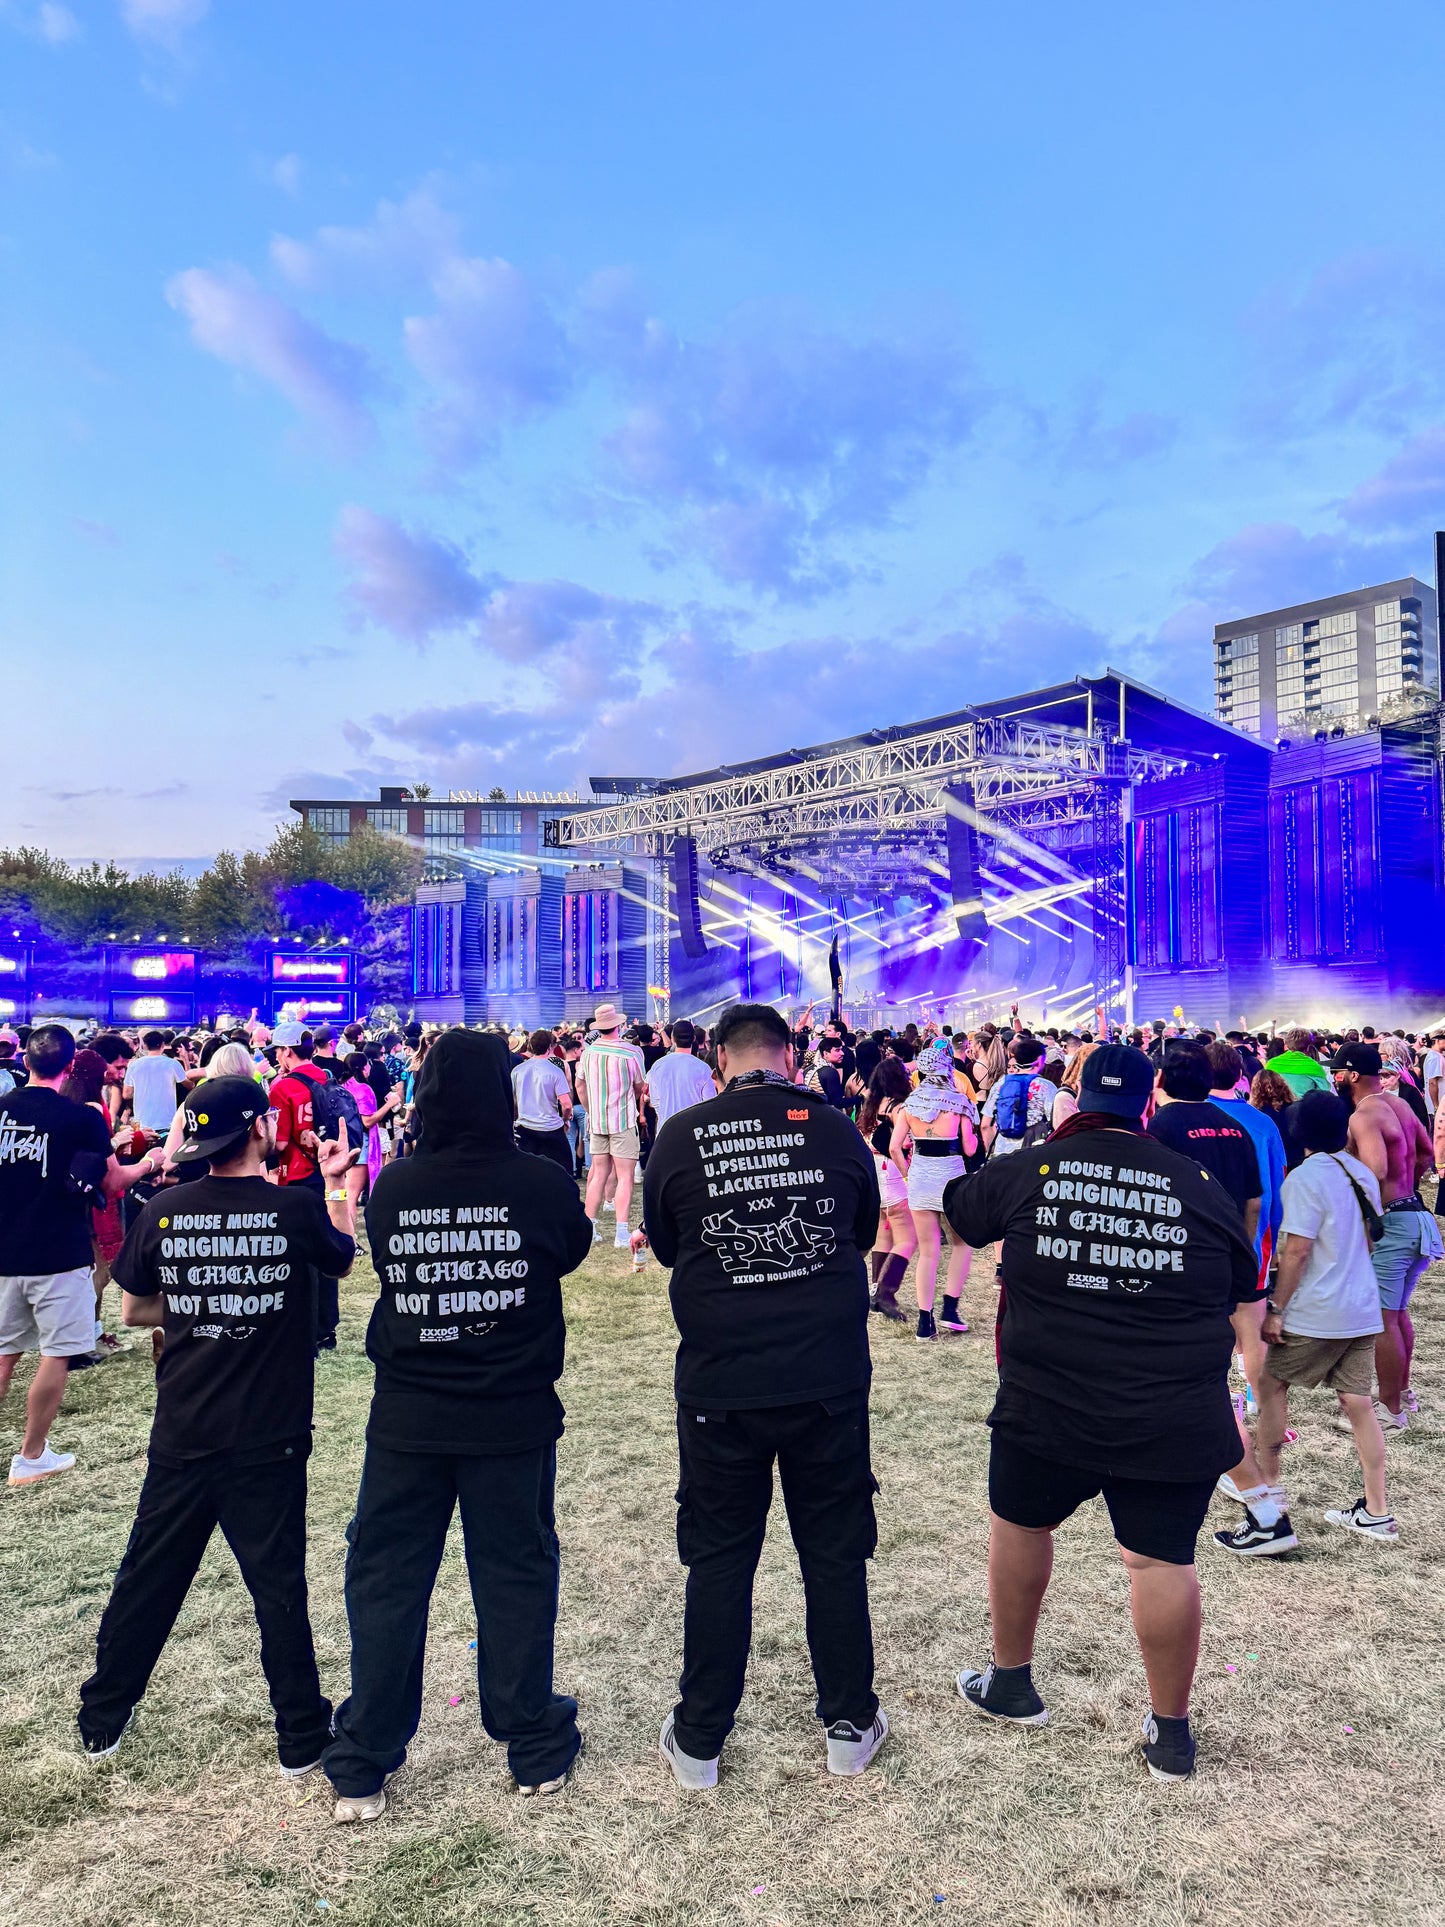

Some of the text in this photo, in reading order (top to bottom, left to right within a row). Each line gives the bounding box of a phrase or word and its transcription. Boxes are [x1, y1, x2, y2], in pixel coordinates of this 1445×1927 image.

[185, 1109, 198, 1132] B
[694, 1118, 762, 1140] P.ROFITS
[699, 1133, 804, 1158] L.AUNDERING
[704, 1153, 789, 1177] U.PSELLING
[1059, 1161, 1170, 1191] HOUSE MUSIC
[708, 1168, 824, 1197] R.ACKETEERING
[747, 1197, 775, 1212] XXX
[1043, 1180, 1181, 1218] ORIGINATED
[173, 1213, 277, 1230] HOUSE MUSIC
[399, 1207, 508, 1226] HOUSE MUSIC
[1036, 1207, 1187, 1245] IN CHICAGO
[161, 1236, 287, 1258] ORIGINATED
[389, 1230, 520, 1255] ORIGINATED
[1037, 1235, 1184, 1271] NOT EUROPE
[159, 1264, 290, 1285] IN CHICAGO
[386, 1260, 528, 1284] IN CHICAGO
[733, 1274, 764, 1284] XXXDCD
[767, 1266, 809, 1281] HOLDINGS,
[1067, 1273, 1108, 1284] XXXDCD
[167, 1291, 284, 1316] NOT EUROPE
[396, 1288, 525, 1315] NOT EUROPE
[420, 1326, 459, 1338] XXXDCD
